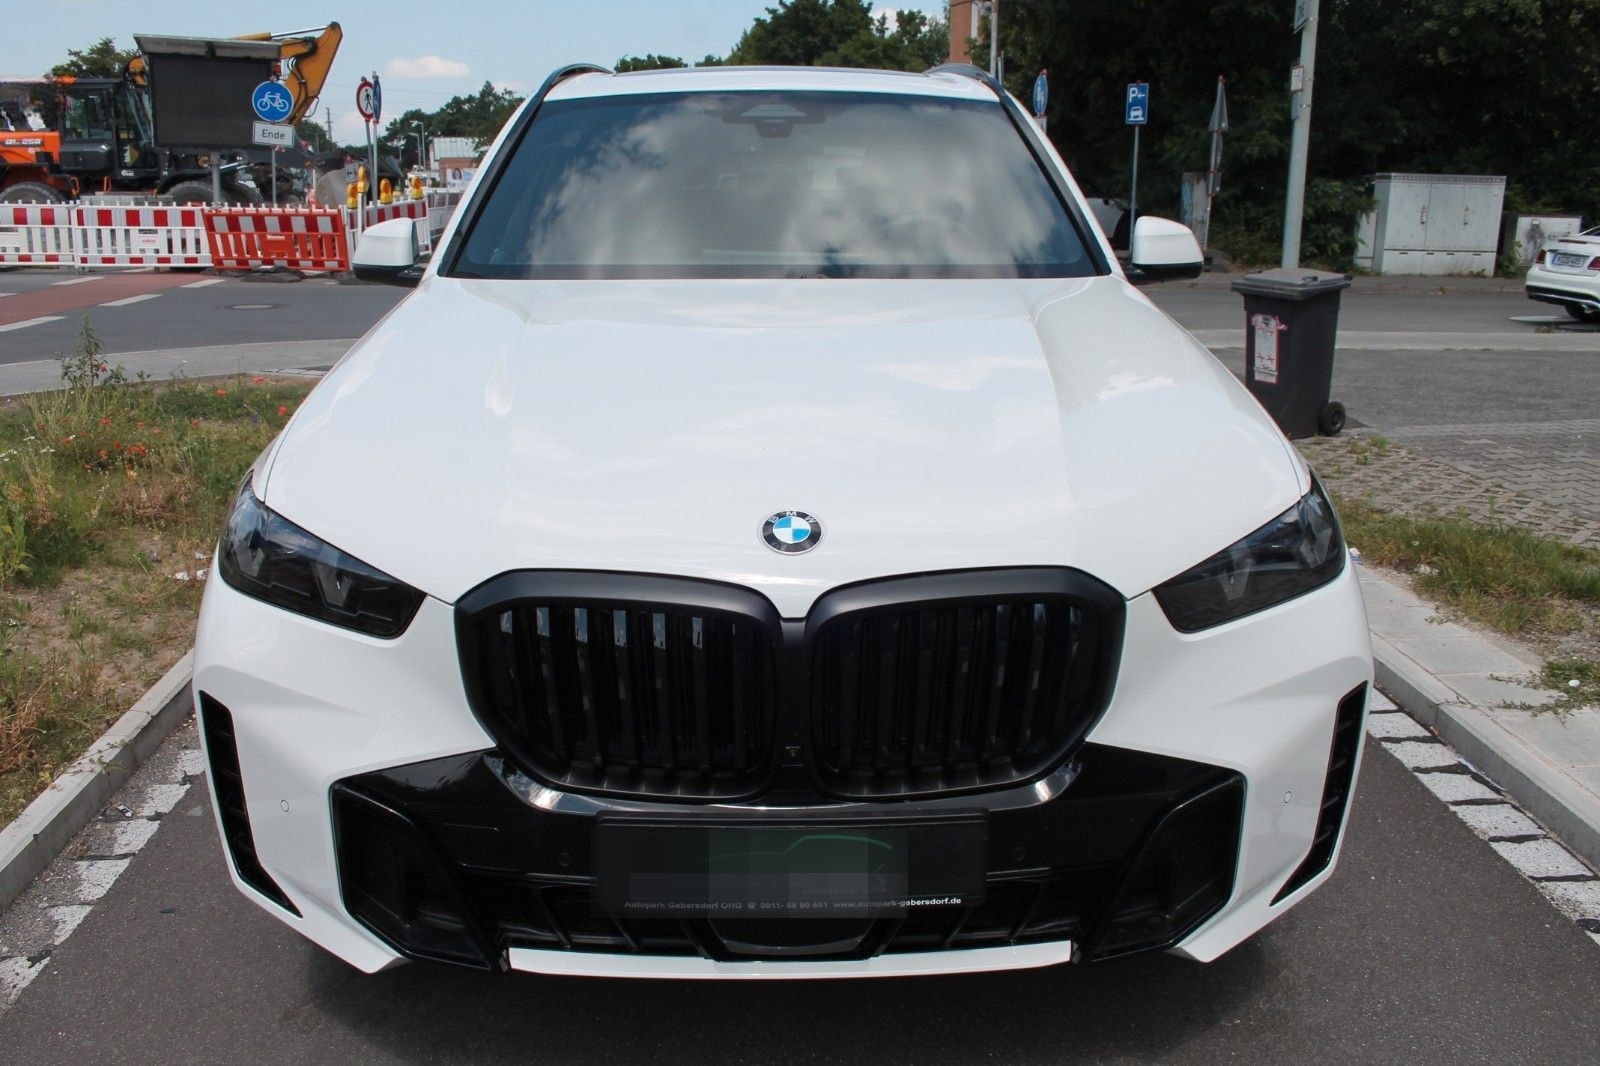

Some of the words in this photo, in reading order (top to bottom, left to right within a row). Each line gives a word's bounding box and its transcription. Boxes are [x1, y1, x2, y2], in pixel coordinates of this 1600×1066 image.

[1129, 87, 1138, 103] P
[261, 129, 285, 140] Ende
[768, 510, 816, 524] BMW
[623, 900, 666, 911] Autopark
[668, 901, 718, 910] Gebersdorf
[720, 901, 743, 910] OHG
[832, 897, 962, 910] www.autopark-gebersdorf.de
